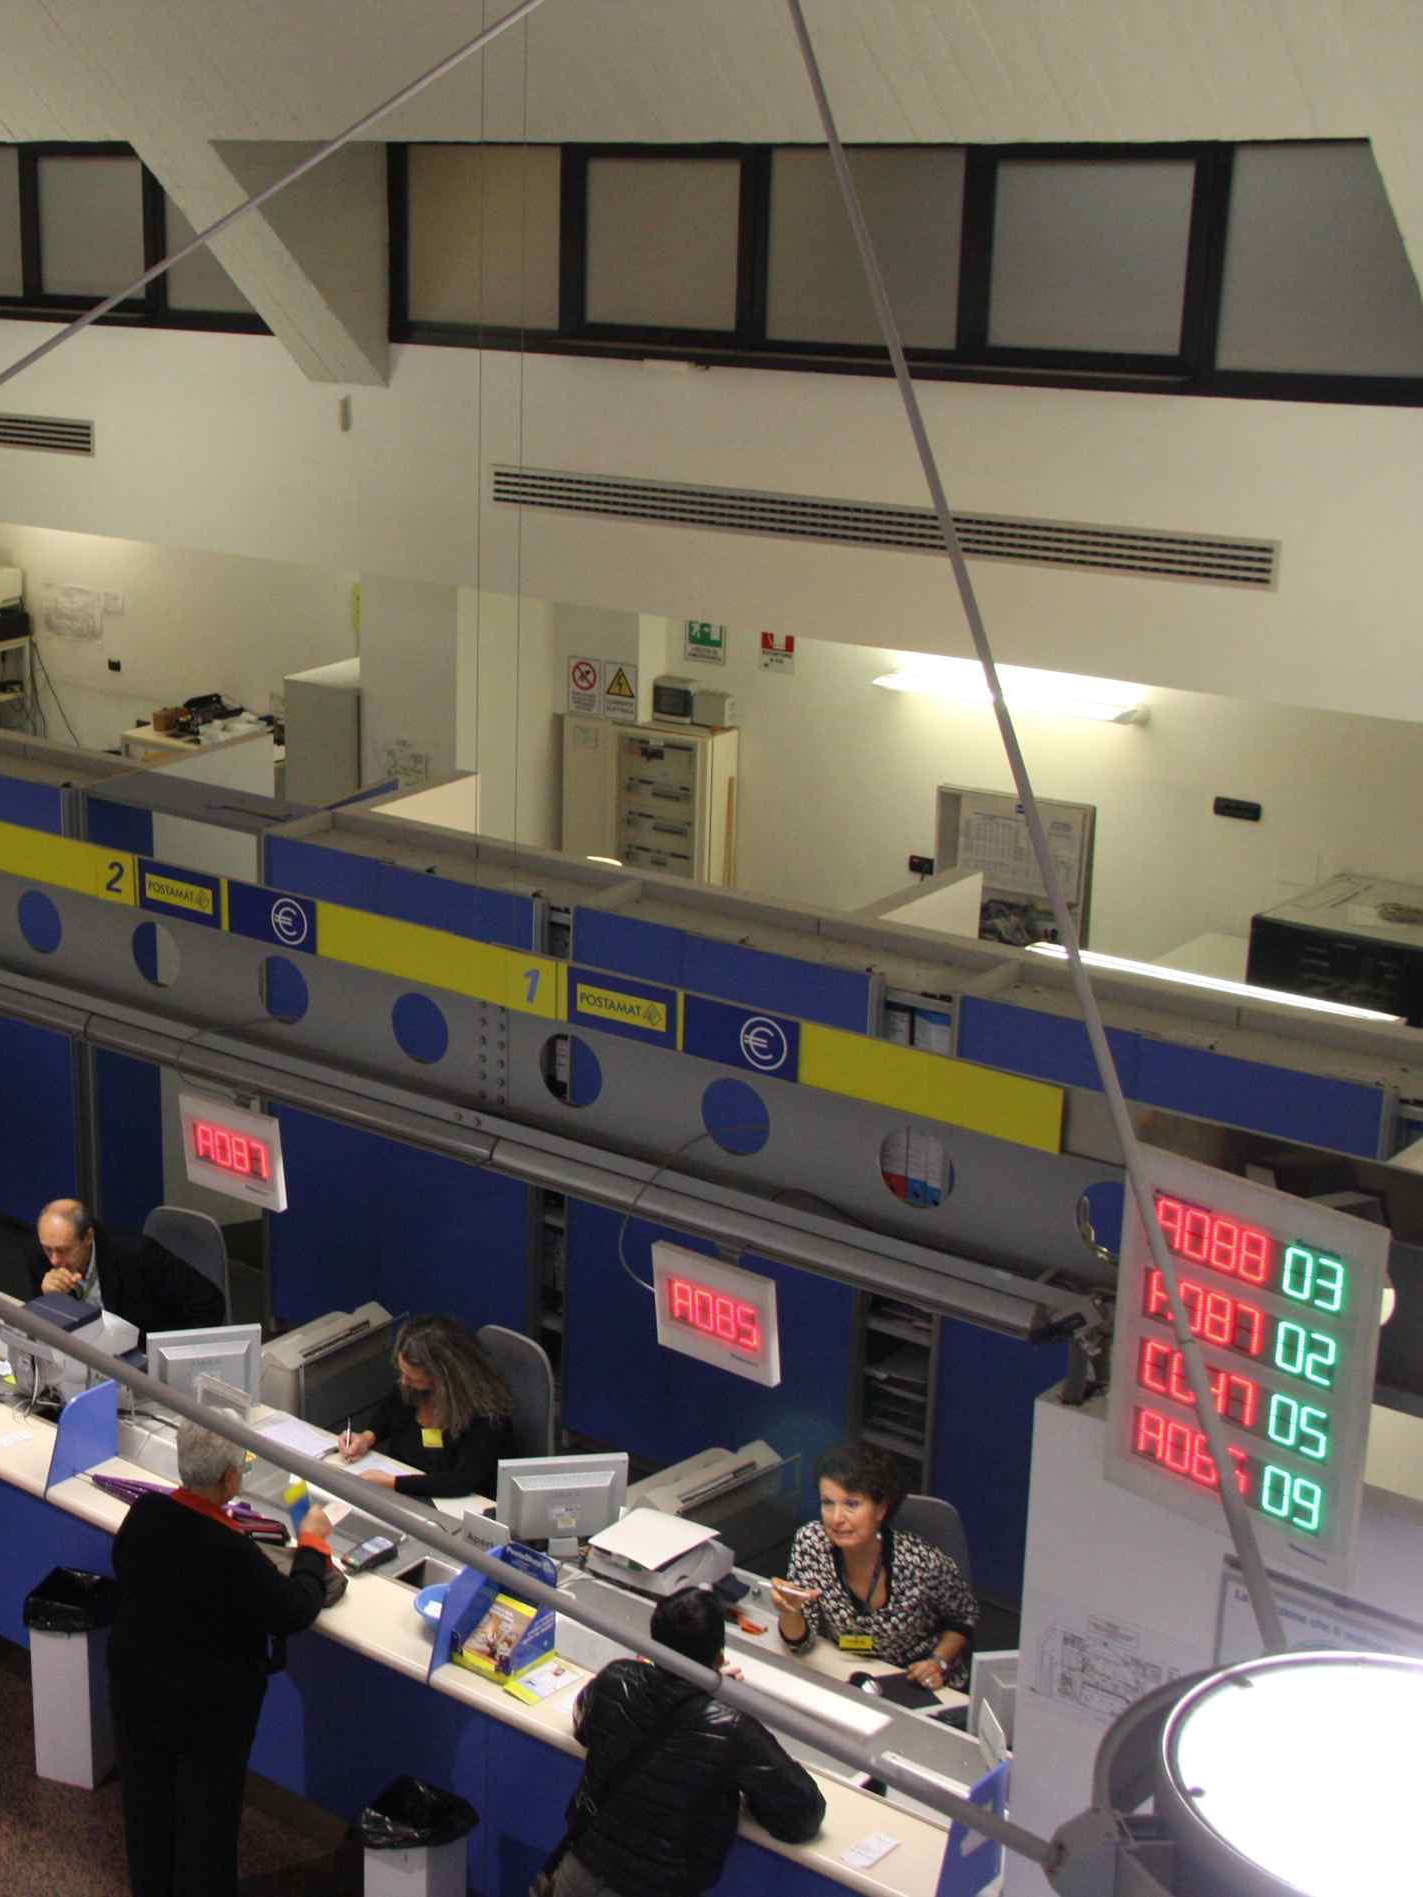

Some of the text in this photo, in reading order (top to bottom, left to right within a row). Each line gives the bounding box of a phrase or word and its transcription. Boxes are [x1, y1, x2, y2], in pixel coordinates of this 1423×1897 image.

[104, 861, 125, 893] 2
[148, 882, 194, 902] POSTAMAT
[522, 968, 540, 1004] 1
[579, 991, 642, 1017] POSTAMAT
[197, 1124, 269, 1180] A087
[1282, 1246, 1344, 1312] 03
[672, 1280, 759, 1347] A085
[1274, 1320, 1337, 1387] 02
[1267, 1393, 1330, 1460] 05
[1261, 1465, 1322, 1531] 09
